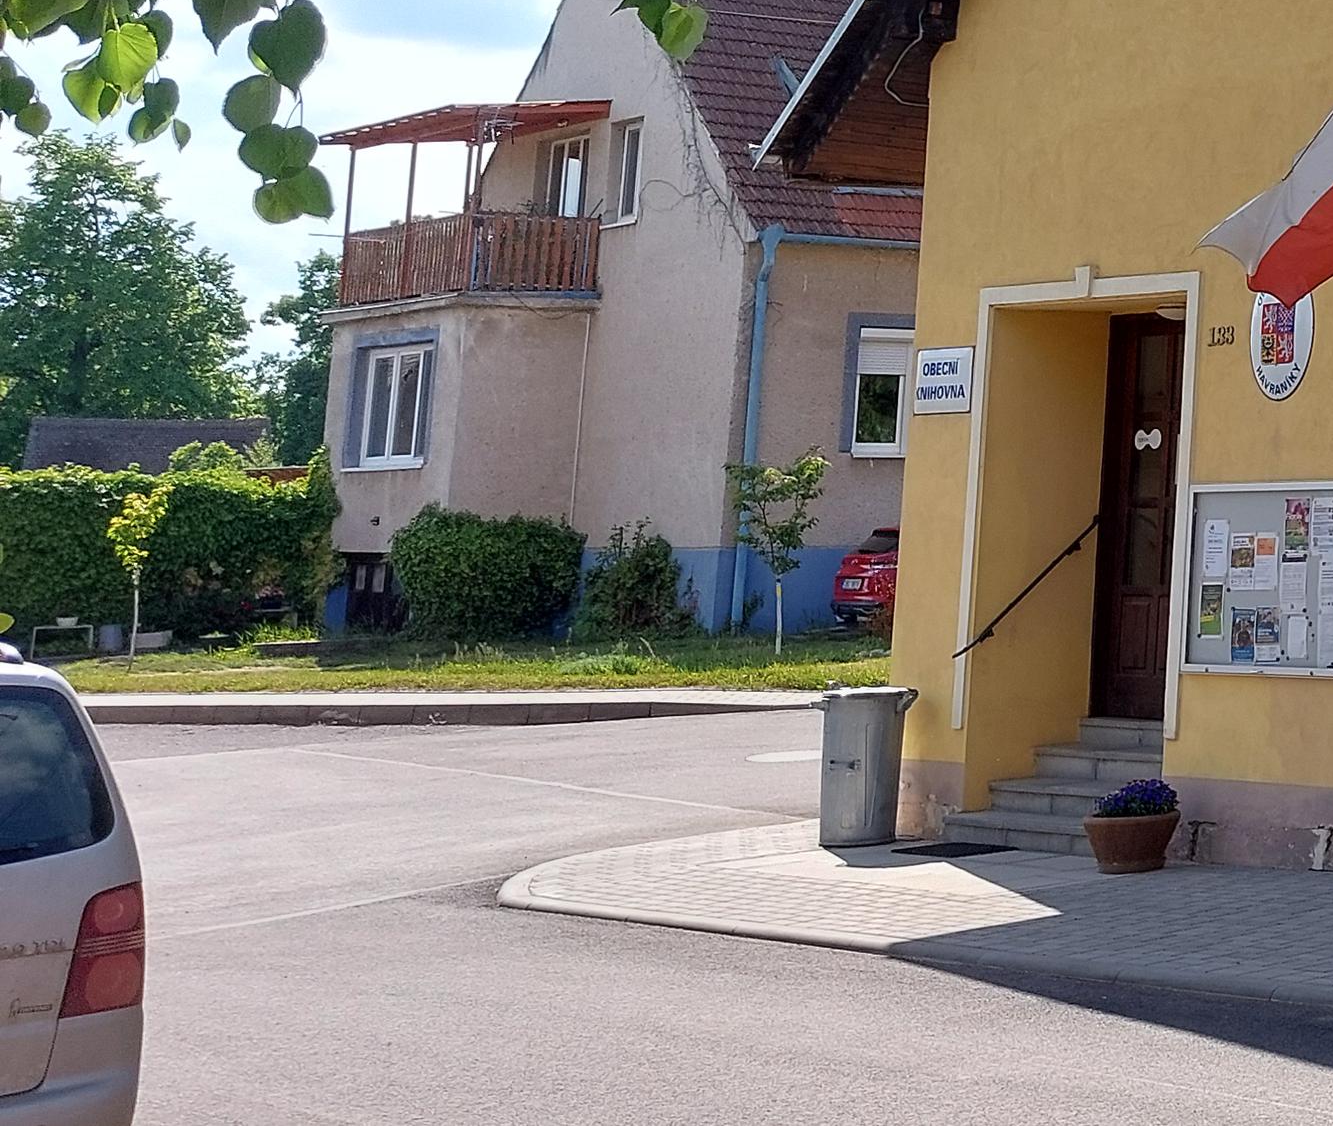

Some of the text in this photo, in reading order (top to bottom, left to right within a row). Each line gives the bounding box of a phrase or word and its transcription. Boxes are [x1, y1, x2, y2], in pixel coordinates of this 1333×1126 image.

[1208, 326, 1235, 347] 133
[922, 357, 960, 377] OBECNÍ
[1256, 362, 1301, 396] HAVRANÍKY
